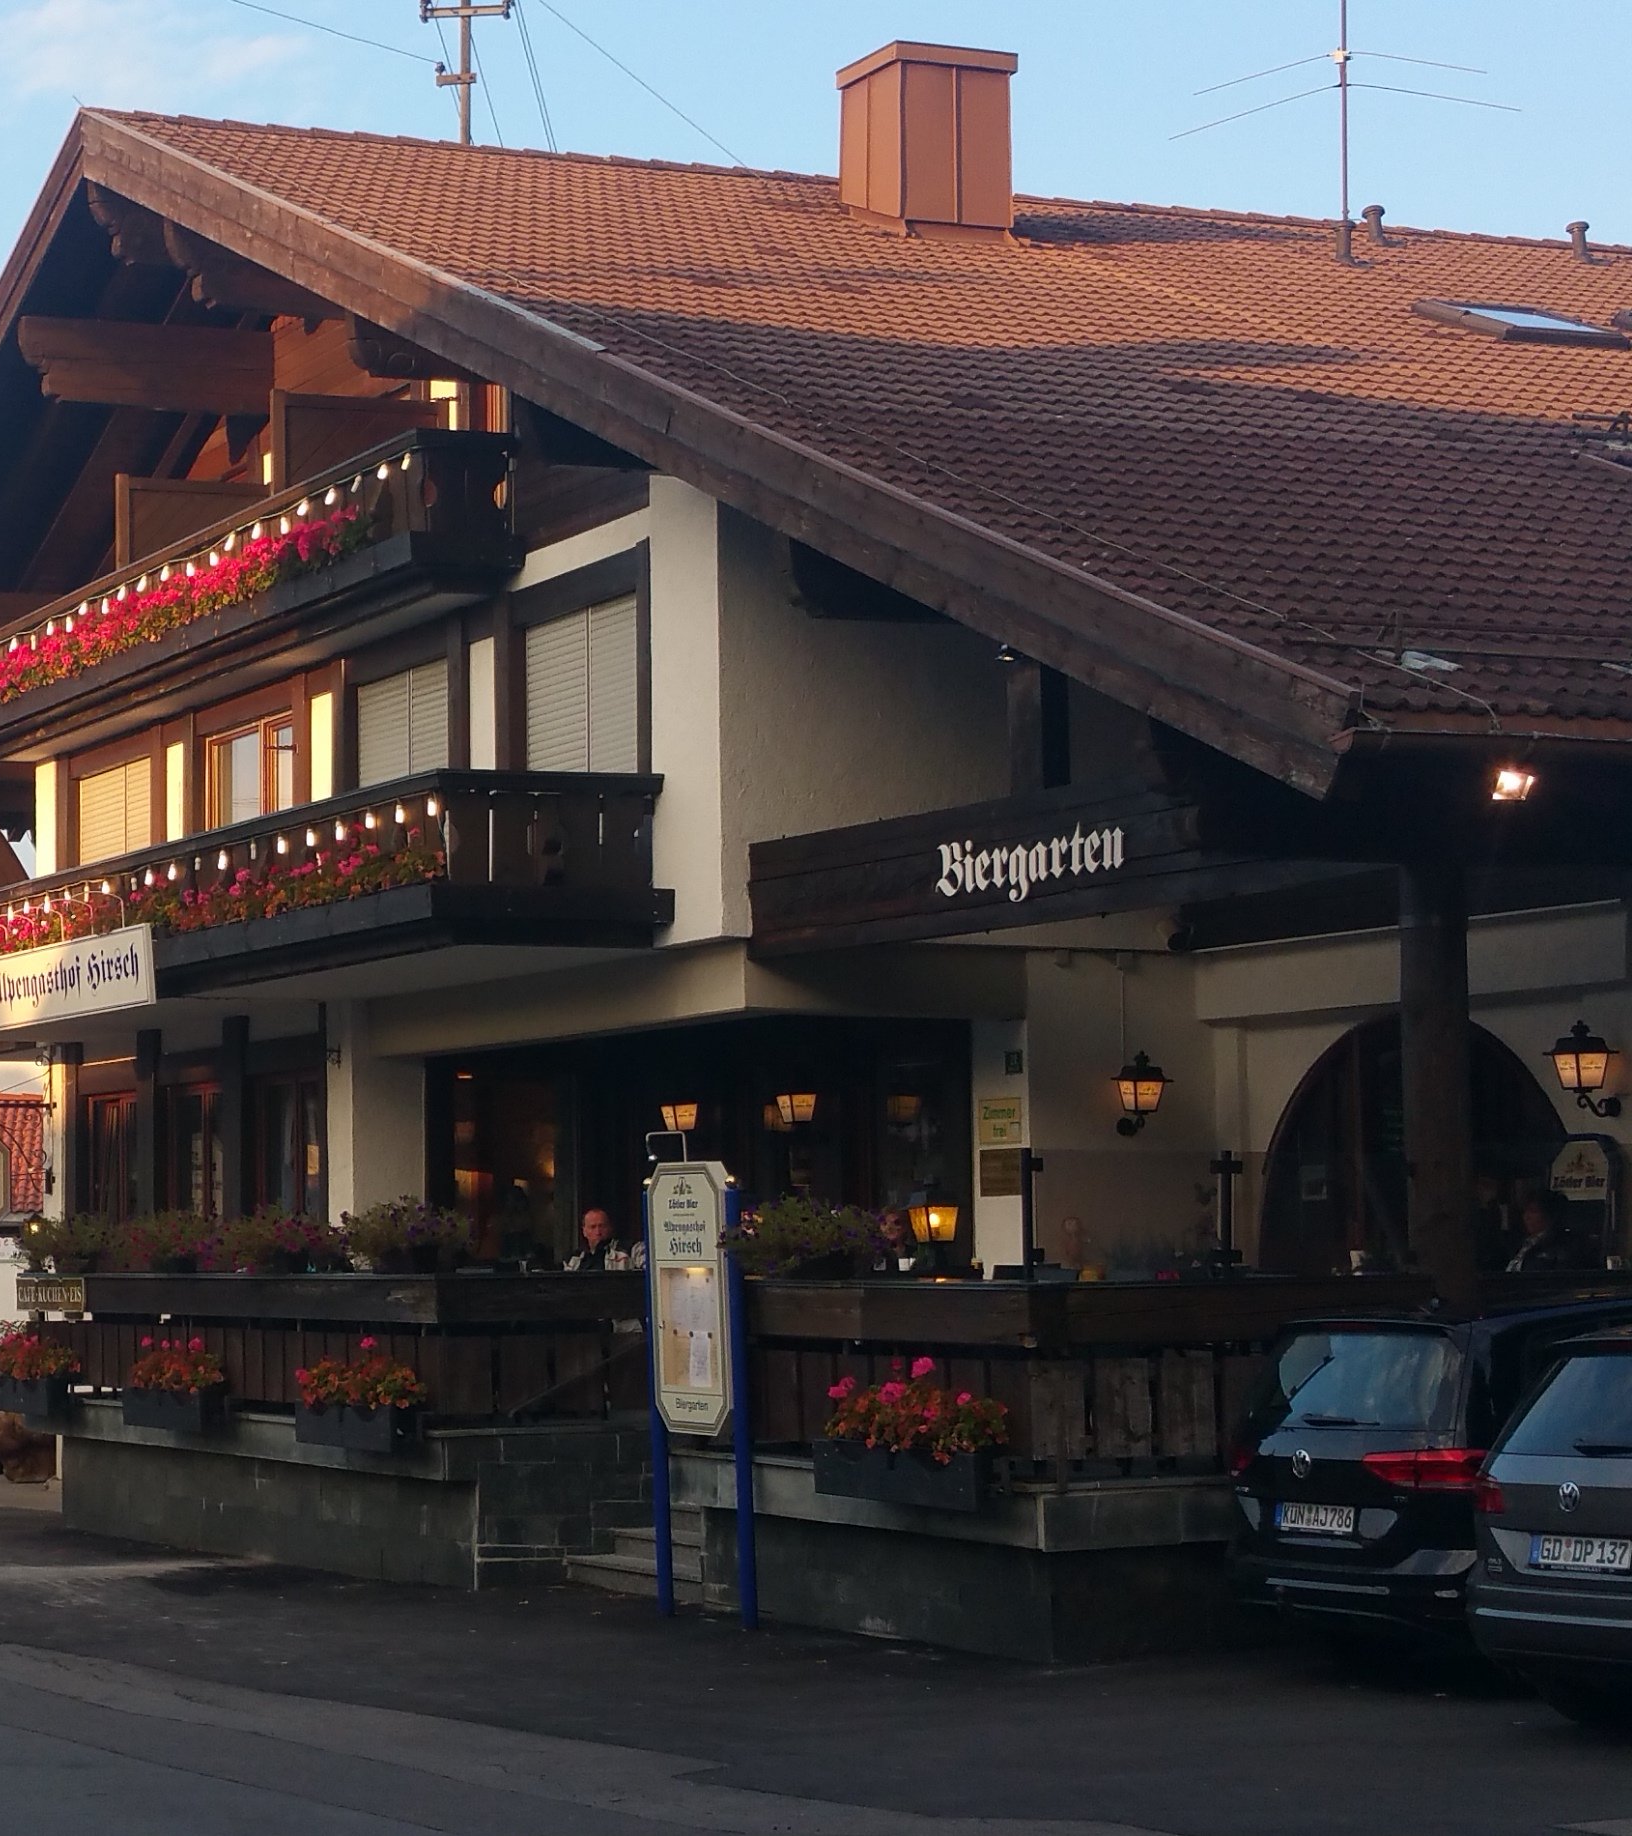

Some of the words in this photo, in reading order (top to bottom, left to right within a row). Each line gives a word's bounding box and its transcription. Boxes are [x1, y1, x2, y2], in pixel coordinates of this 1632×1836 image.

[935, 821, 1125, 903] Biergarten
[87, 942, 140, 997] Hirsch
[982, 1105, 1016, 1120] Zimmer
[993, 1124, 1007, 1137] frei
[669, 1237, 702, 1258] Hirsch
[675, 1397, 709, 1413] Biergarten
[1540, 1537, 1562, 1561] GD
[1573, 1539, 1594, 1563] DP
[1596, 1540, 1629, 1565] 137
